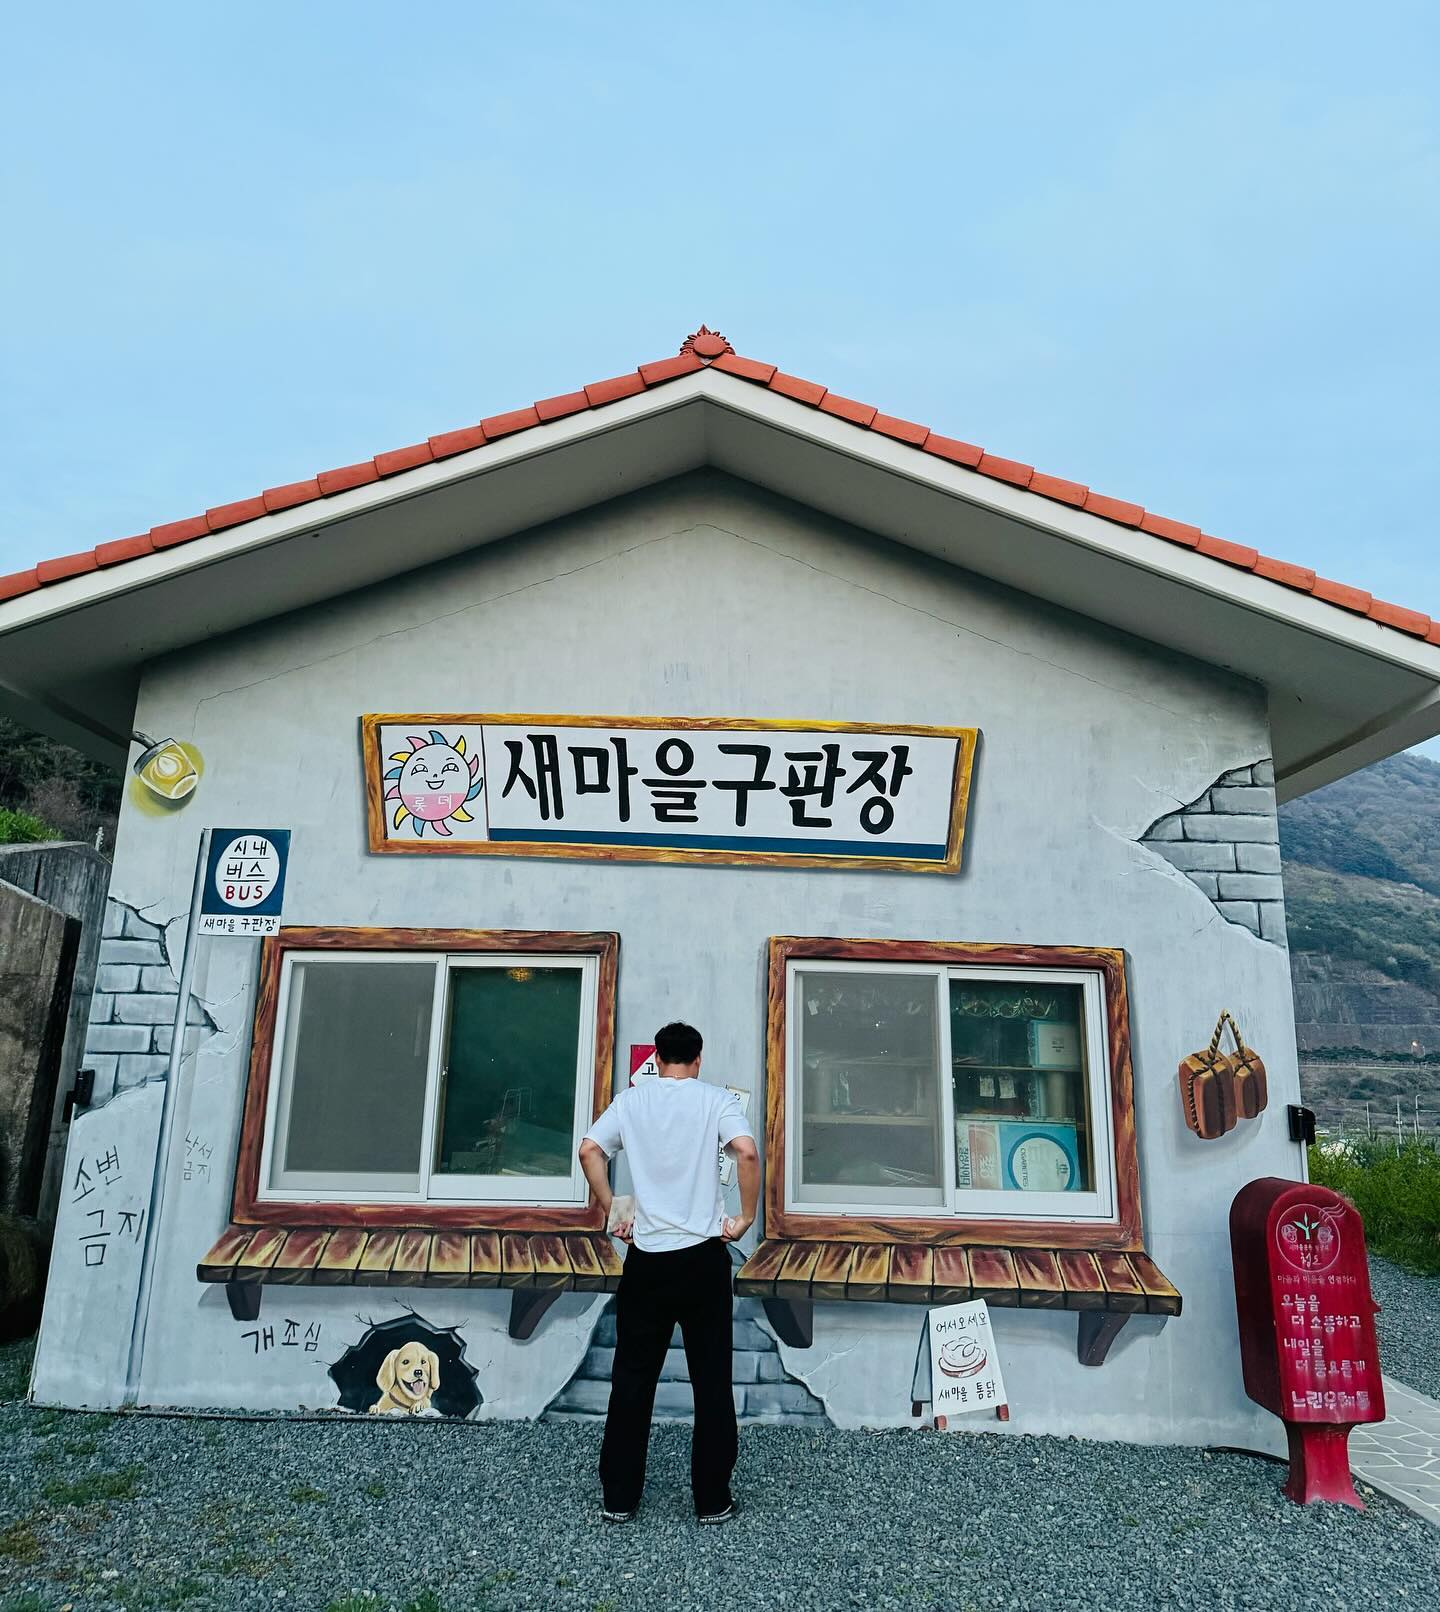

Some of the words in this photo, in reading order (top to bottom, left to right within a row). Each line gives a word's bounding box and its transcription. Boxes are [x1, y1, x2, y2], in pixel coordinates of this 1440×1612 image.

[502, 734, 912, 835] 새마을구판장
[234, 840, 268, 855] 시내
[226, 861, 265, 879] 버스
[225, 885, 263, 900] BUS
[204, 918, 237, 932] 새마을
[241, 917, 276, 932] 구판장
[185, 1130, 212, 1159] 낙서
[72, 1145, 122, 1203] 소변
[183, 1161, 211, 1184] 금지
[78, 1209, 145, 1266] 금지
[1281, 1294, 1320, 1312] 오늘을
[936, 1312, 986, 1332] 어서오세요
[1291, 1315, 1304, 1325] 더
[1284, 1338, 1324, 1356] 내일을
[1296, 1360, 1308, 1370] 더
[939, 1386, 968, 1402] 새마을
[976, 1379, 996, 1400] 통닭
